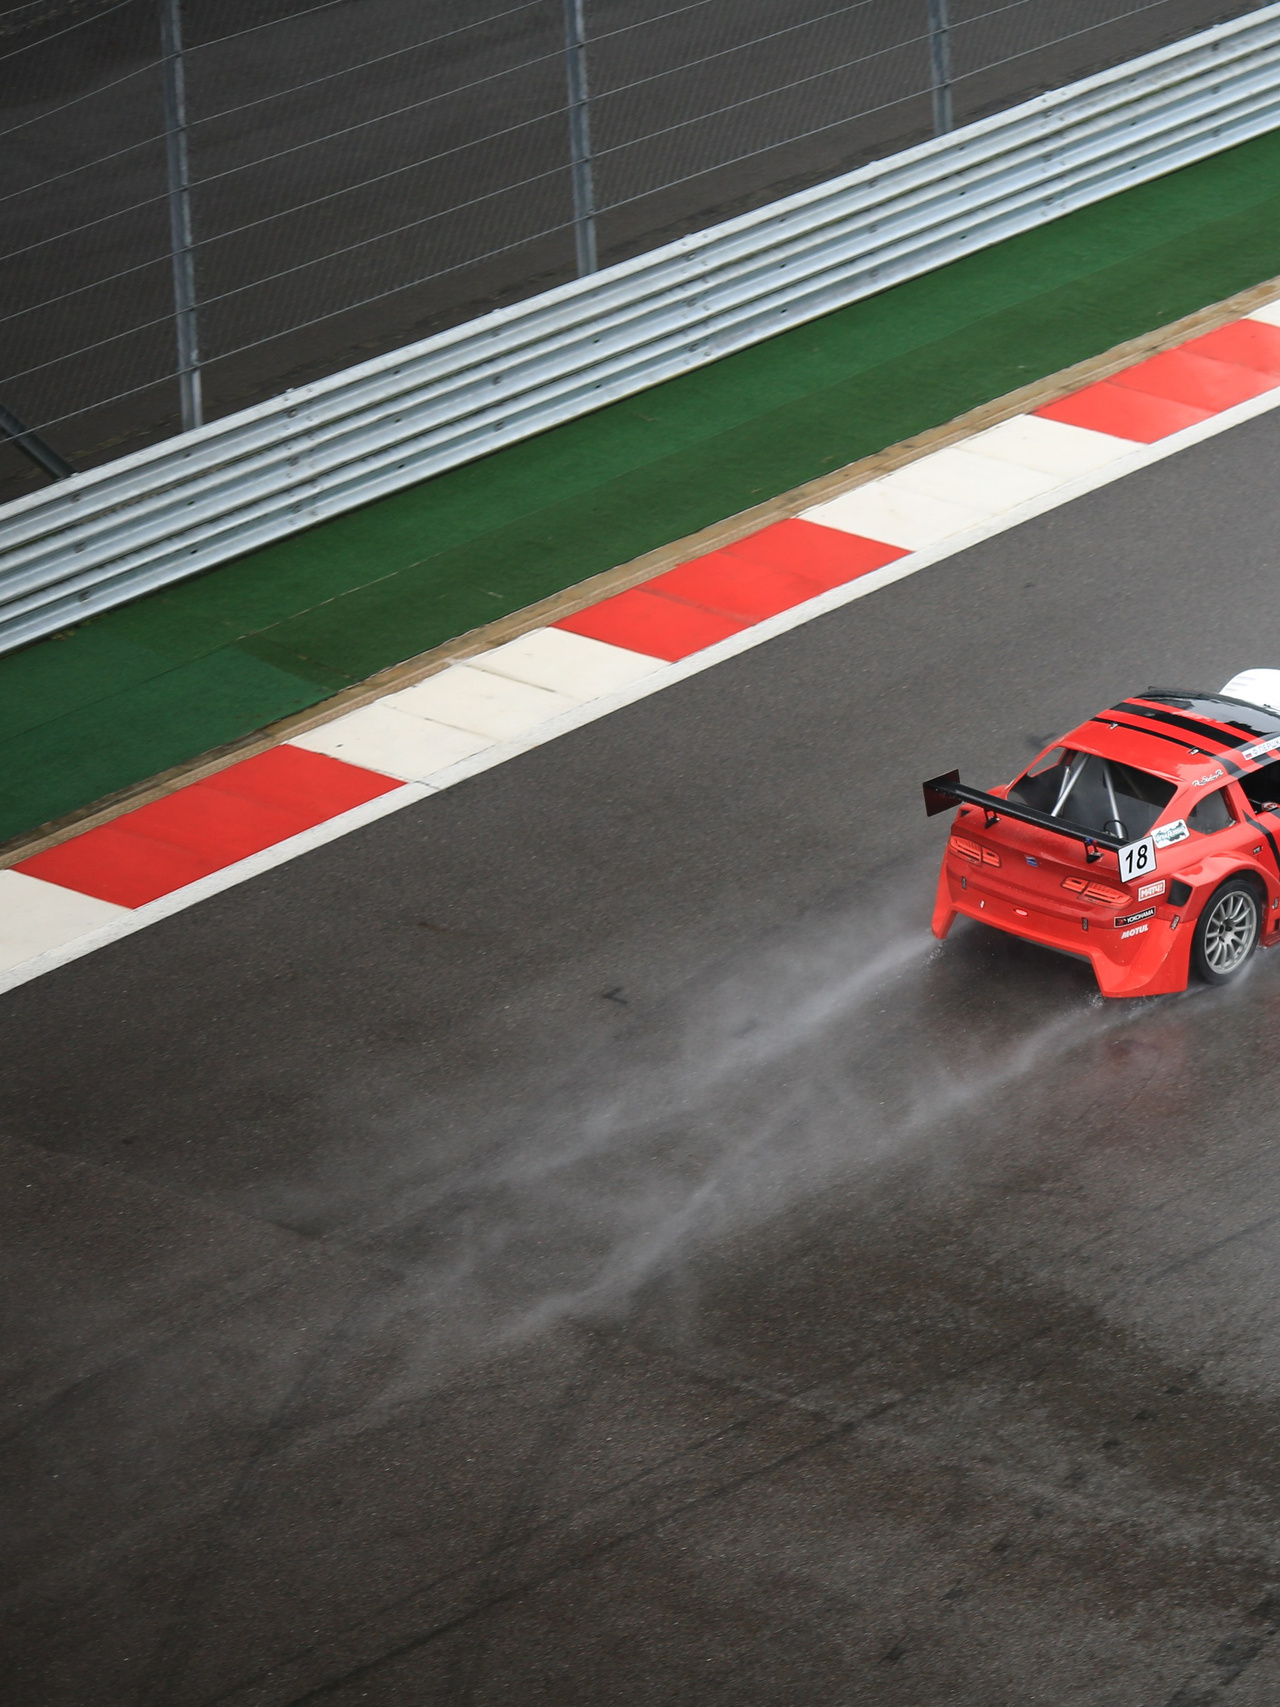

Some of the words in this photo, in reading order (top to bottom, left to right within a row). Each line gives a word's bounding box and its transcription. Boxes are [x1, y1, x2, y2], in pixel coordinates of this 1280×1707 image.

[1125, 844, 1148, 874] 18
[1127, 909, 1154, 923] YOKOHAMA
[1121, 924, 1149, 940] MOTUL
